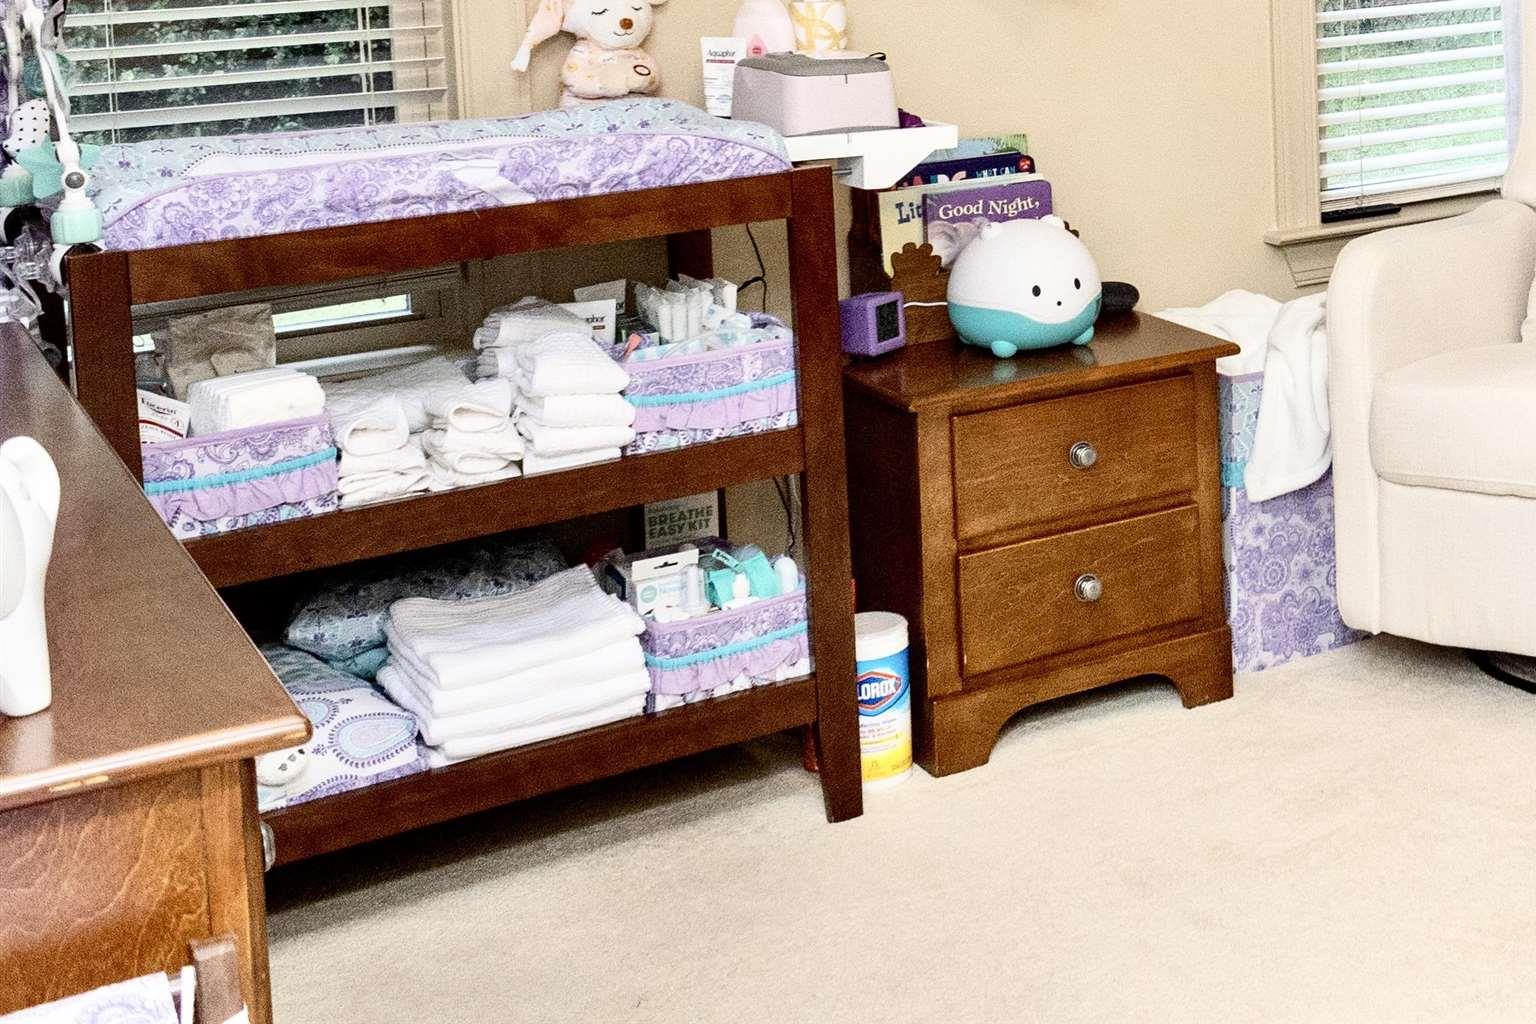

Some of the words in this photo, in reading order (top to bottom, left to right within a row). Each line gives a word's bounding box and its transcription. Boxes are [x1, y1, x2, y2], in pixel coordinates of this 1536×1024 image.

[939, 199, 984, 219] Good
[988, 196, 1040, 217] Night,
[648, 505, 713, 528] BREATHE
[649, 522, 686, 539] EASY
[688, 518, 711, 532] KIT
